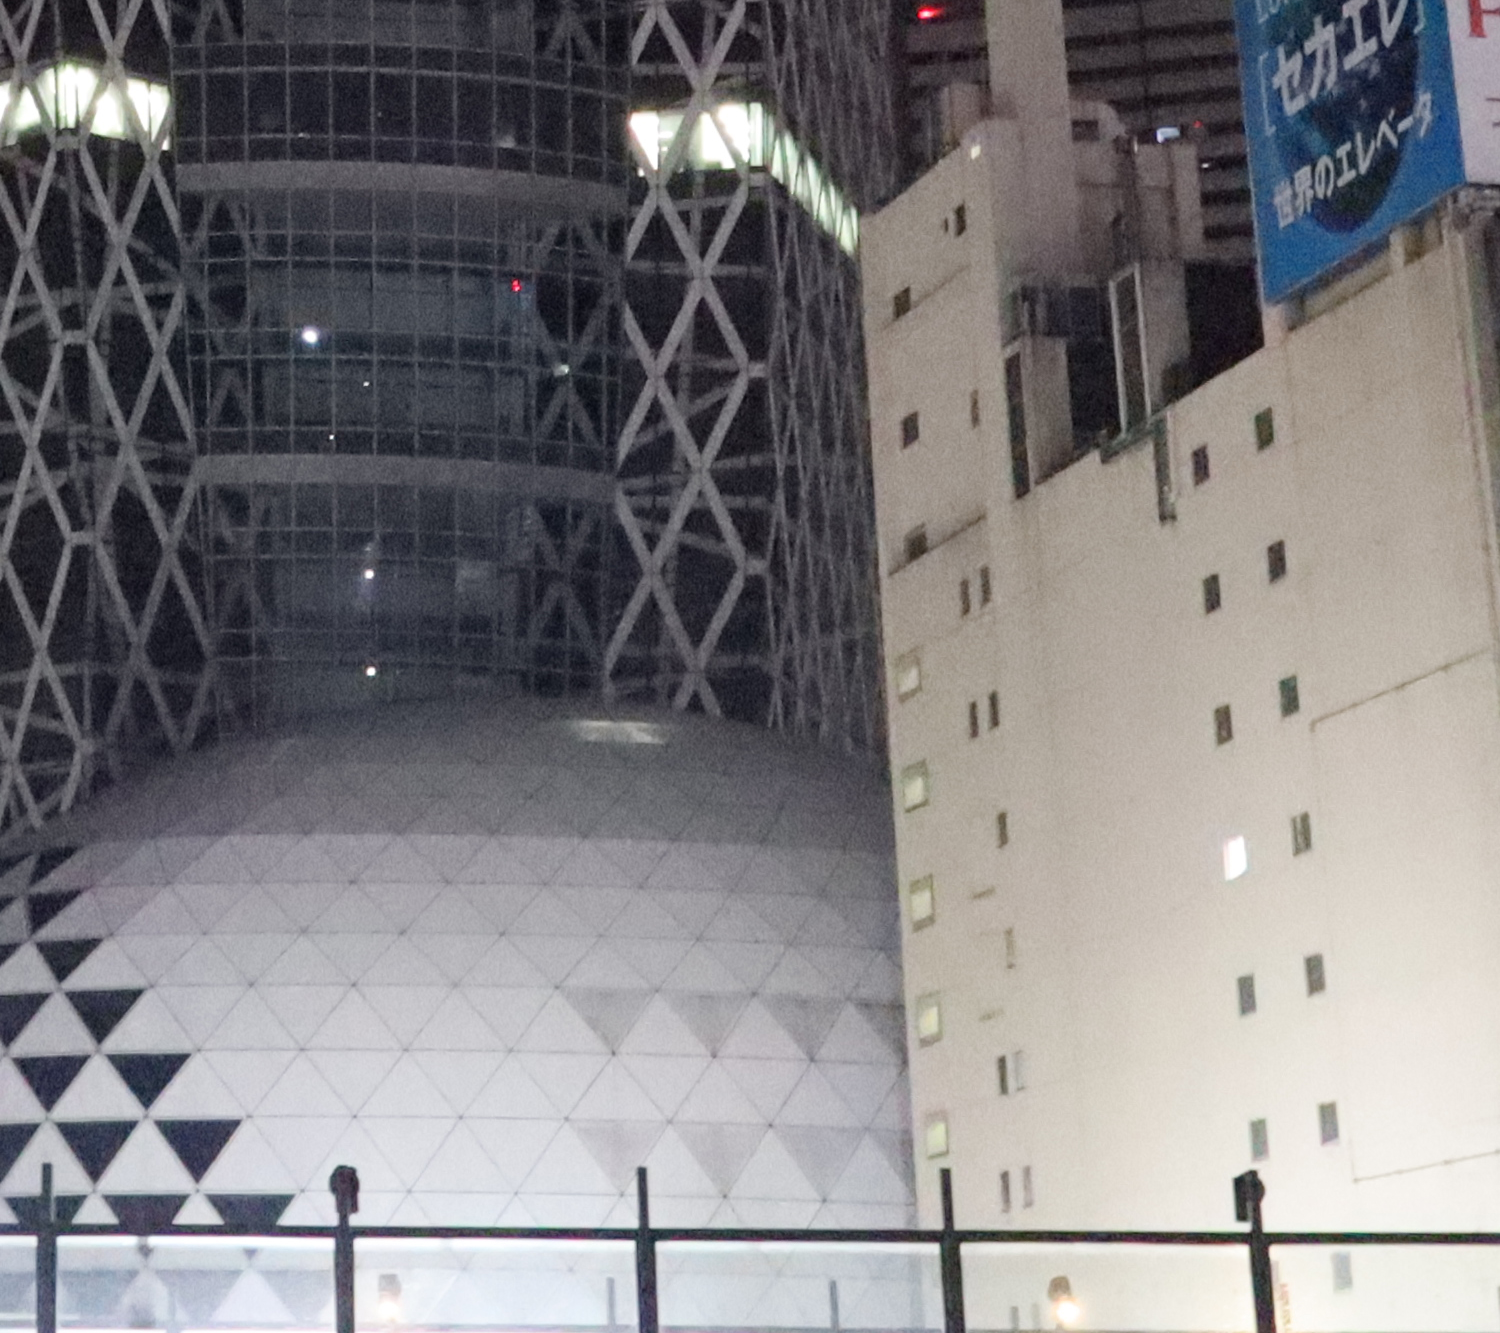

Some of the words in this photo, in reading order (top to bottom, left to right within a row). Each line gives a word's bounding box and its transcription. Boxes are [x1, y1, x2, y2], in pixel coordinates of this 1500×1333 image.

[1273, 89, 1434, 230] 世界のエレベータ
